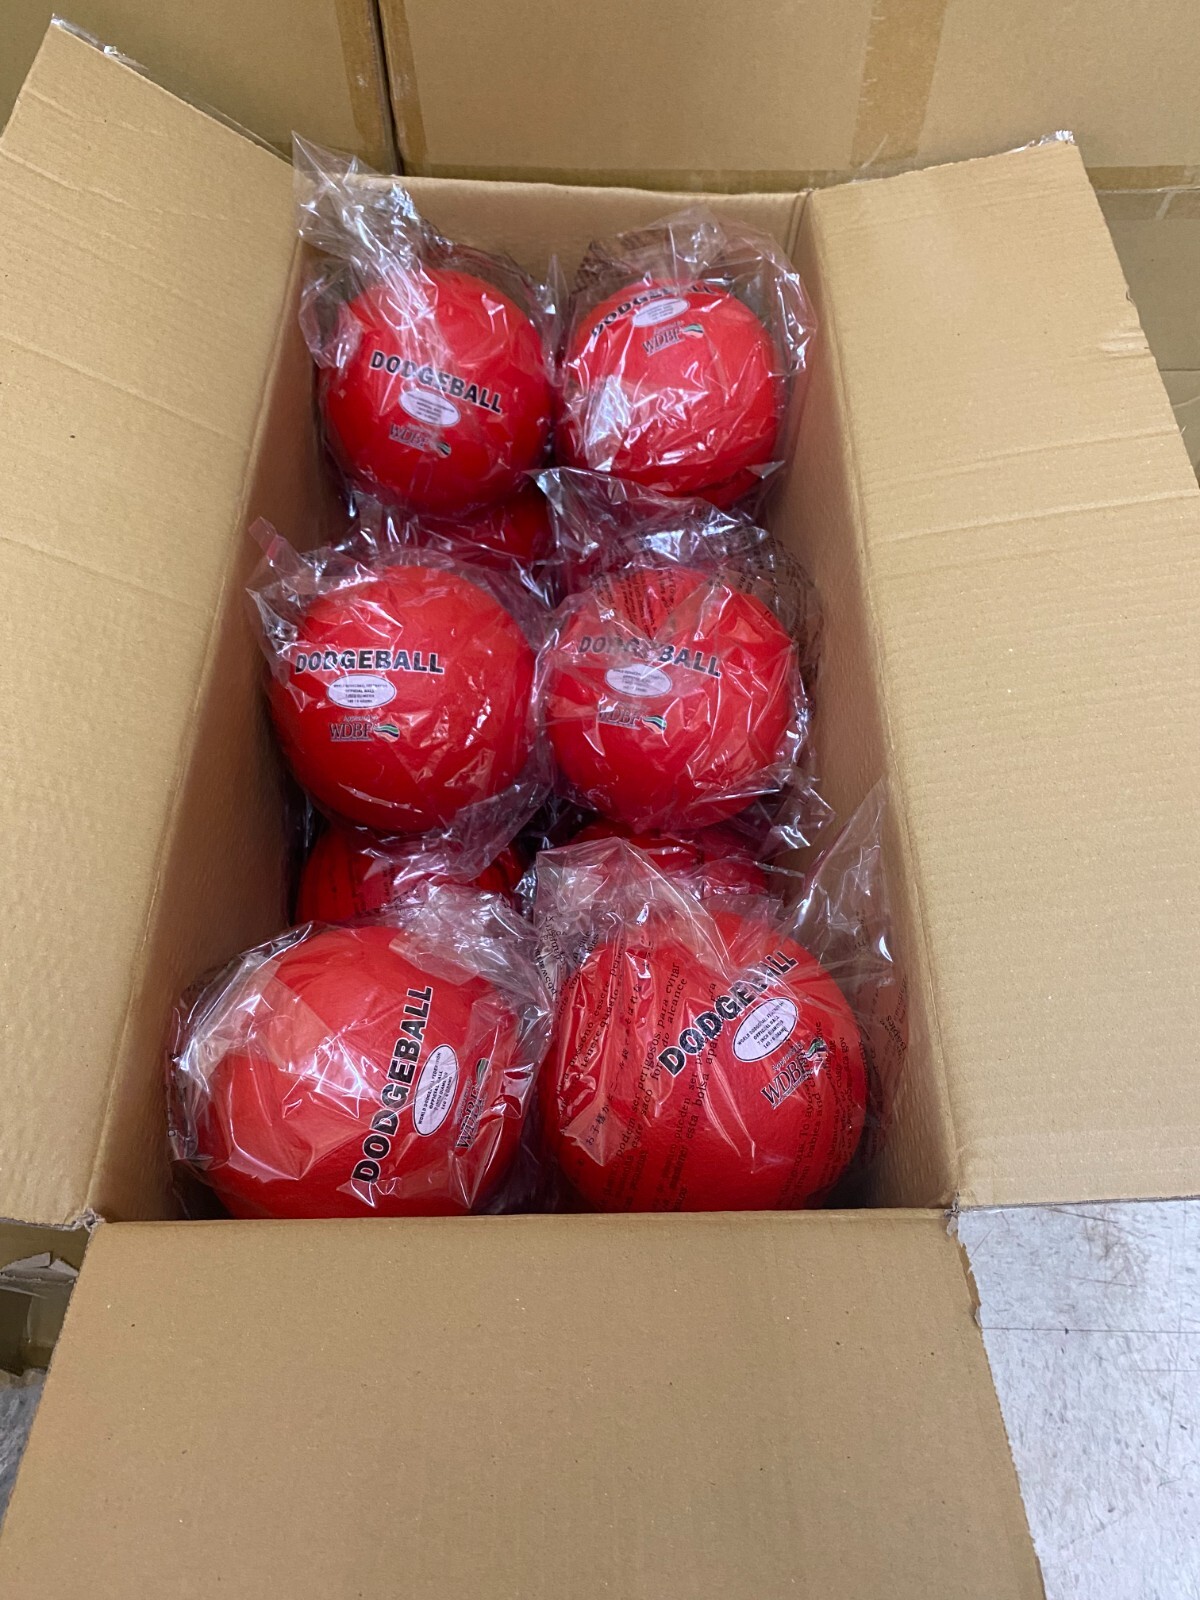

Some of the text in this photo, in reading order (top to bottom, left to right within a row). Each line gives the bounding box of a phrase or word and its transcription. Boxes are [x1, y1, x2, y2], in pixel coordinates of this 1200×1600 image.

[370, 350, 501, 414] DODGEBALL
[295, 650, 444, 674] DODGEBALL
[330, 722, 372, 740] WDBF
[351, 986, 433, 1184] DODGEBALL
[761, 1056, 808, 1103] WDBF
